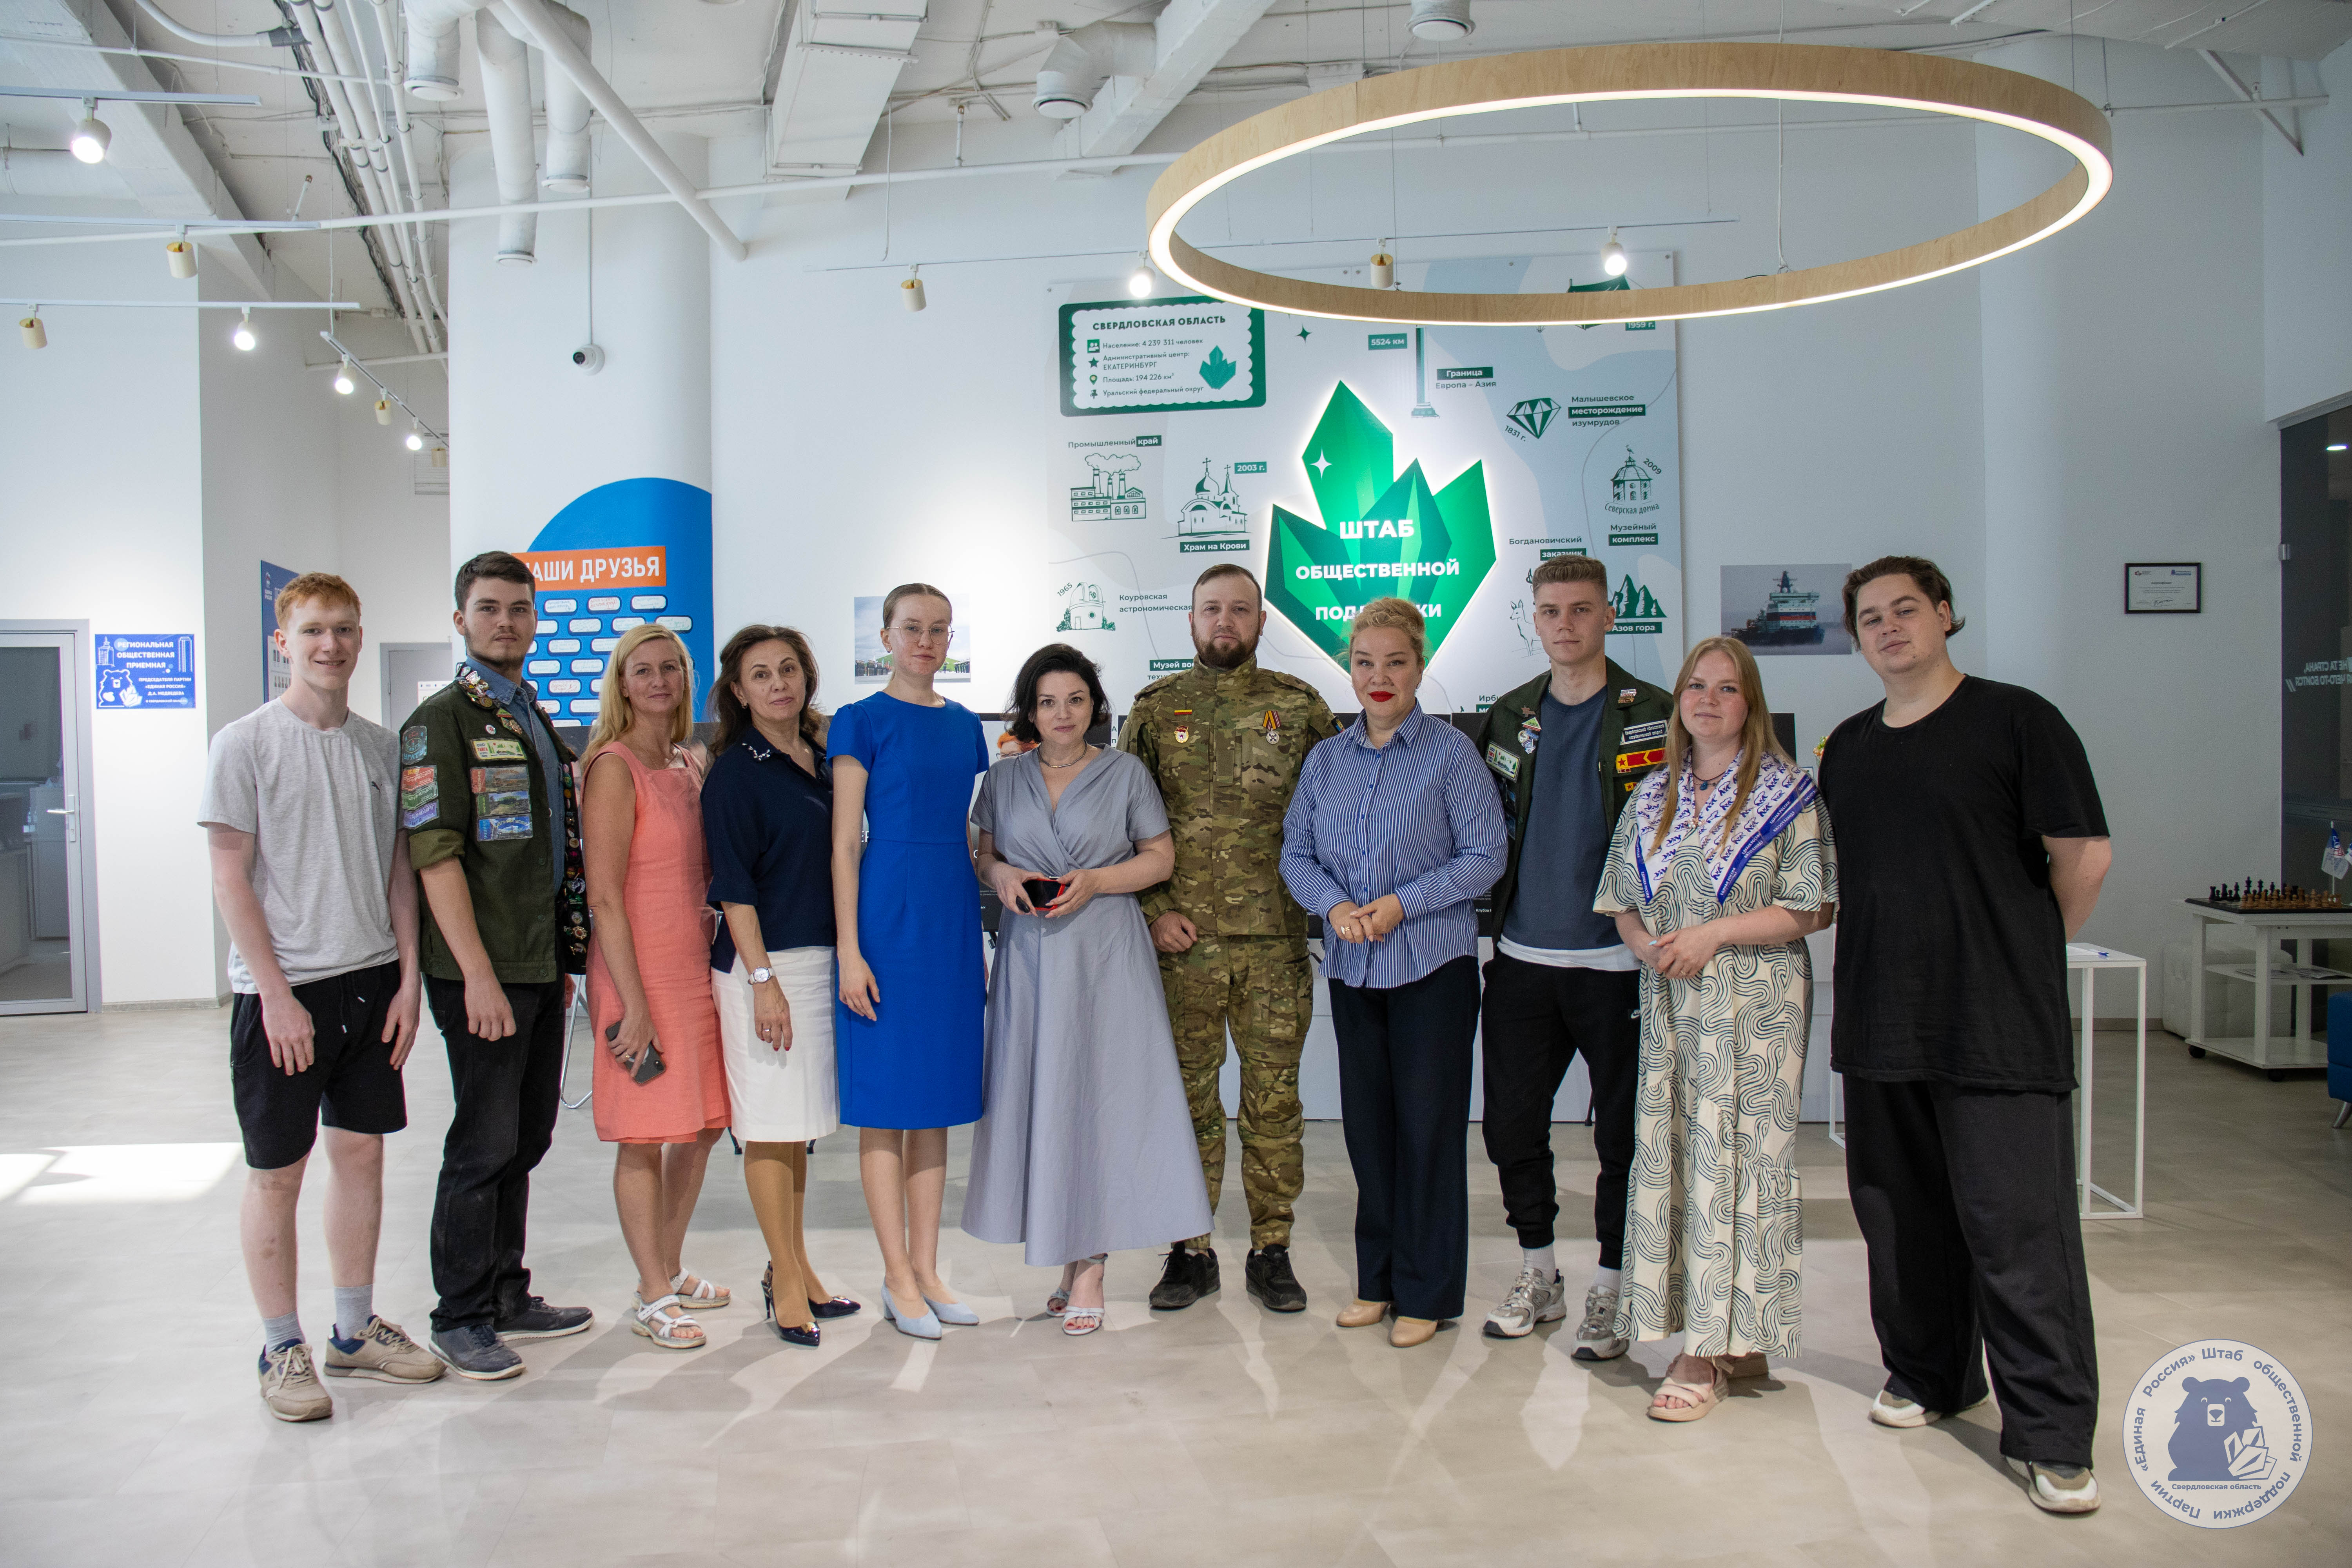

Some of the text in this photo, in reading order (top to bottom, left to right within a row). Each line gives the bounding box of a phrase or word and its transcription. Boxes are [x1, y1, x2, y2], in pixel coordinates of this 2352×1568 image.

[1093, 316, 1226, 330] СВЕРДЛОВСКАЯ ОБЛАСТЬ
[1371, 338, 1390, 346] 5524
[1103, 352, 1167, 362] Административный
[1103, 361, 1157, 370] ЕКАТЕРИНБУРГ
[1446, 368, 1483, 378] Граница
[1103, 376, 1134, 384] Площадь:
[1436, 381, 1466, 390] Европа
[1103, 386, 1203, 397] Уральский федеральный округ
[1572, 395, 1634, 403] Малышевское
[1572, 406, 1642, 416] месторождение
[1572, 419, 1619, 428] изумрудов
[1504, 425, 1519, 437] 1831
[1068, 436, 1158, 448] Промышленный край
[1237, 464, 1257, 472] 2003
[1643, 457, 1662, 475] 2009
[1604, 502, 1659, 515] Северская домна
[1339, 519, 1414, 539] ШТАБ
[1610, 522, 1656, 531] Музейный
[1509, 536, 1582, 546] Богдановичский
[1612, 535, 1655, 544] комплекс
[1184, 543, 1206, 552] Храм
[1220, 541, 1247, 551] Крови
[526, 557, 659, 583] АШИ ДРУЗЬЯ
[1296, 558, 1459, 581] ОБЩЕСТВЕННОЙ
[1057, 583, 1073, 597] 1965
[1119, 593, 1167, 601] Коуровская
[1119, 604, 1192, 612] астрономическая
[1316, 604, 1441, 622] ПОДКИ
[1612, 623, 1655, 633] Азов гора
[1153, 661, 1180, 670] Музей
[1779, 801, 1790, 814] РОССИЯ
